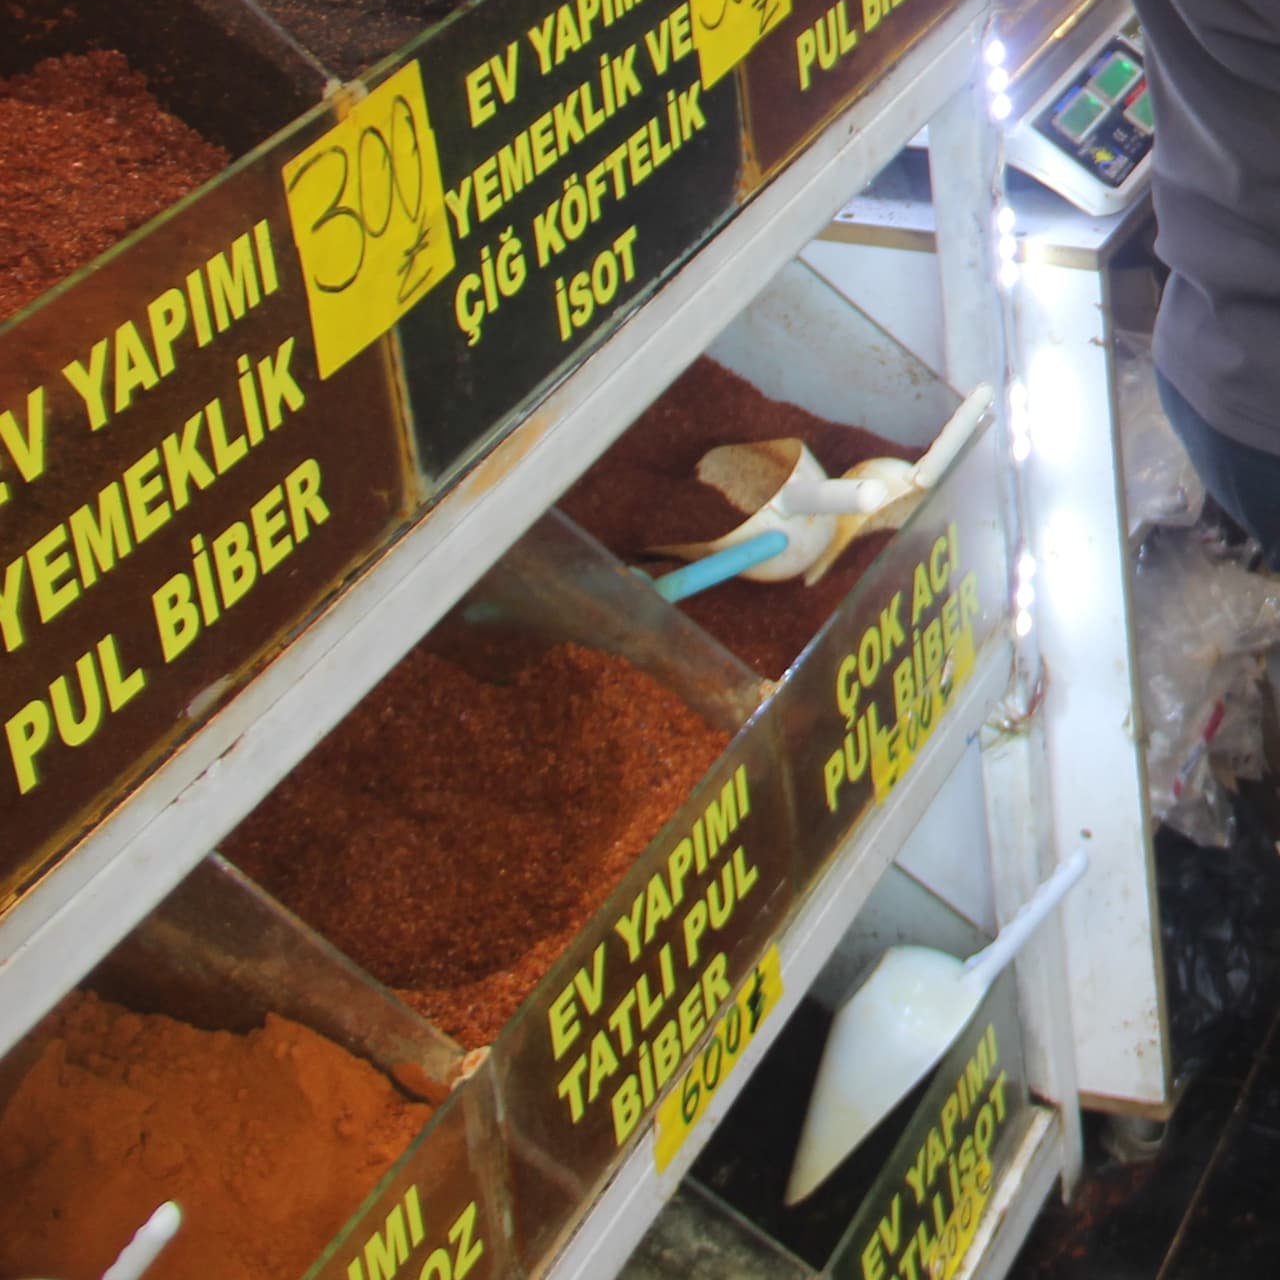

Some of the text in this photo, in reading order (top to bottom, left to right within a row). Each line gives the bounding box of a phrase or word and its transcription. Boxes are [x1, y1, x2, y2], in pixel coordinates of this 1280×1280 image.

[444, 2, 698, 241] YEMEKLİK VE
[464, 40, 518, 128] EV
[796, 7, 858, 91] PUL
[287, 94, 425, 295] 300
[454, 79, 707, 348] ÇİĞ KÖFTELİK
[553, 224, 639, 343] İSOT
[62, 218, 280, 434] YAPIMI
[0, 336, 307, 655] YEMEKLİK
[5, 457, 332, 797] PUL BİBER
[836, 521, 960, 730] ÇOK ACI
[823, 700, 890, 815] PUL
[548, 763, 752, 1062] EV YAPIMI
[557, 844, 759, 1125] TATLI PUL
[610, 950, 733, 1148] BİBER
[906, 1023, 998, 1207] YAPIMI
